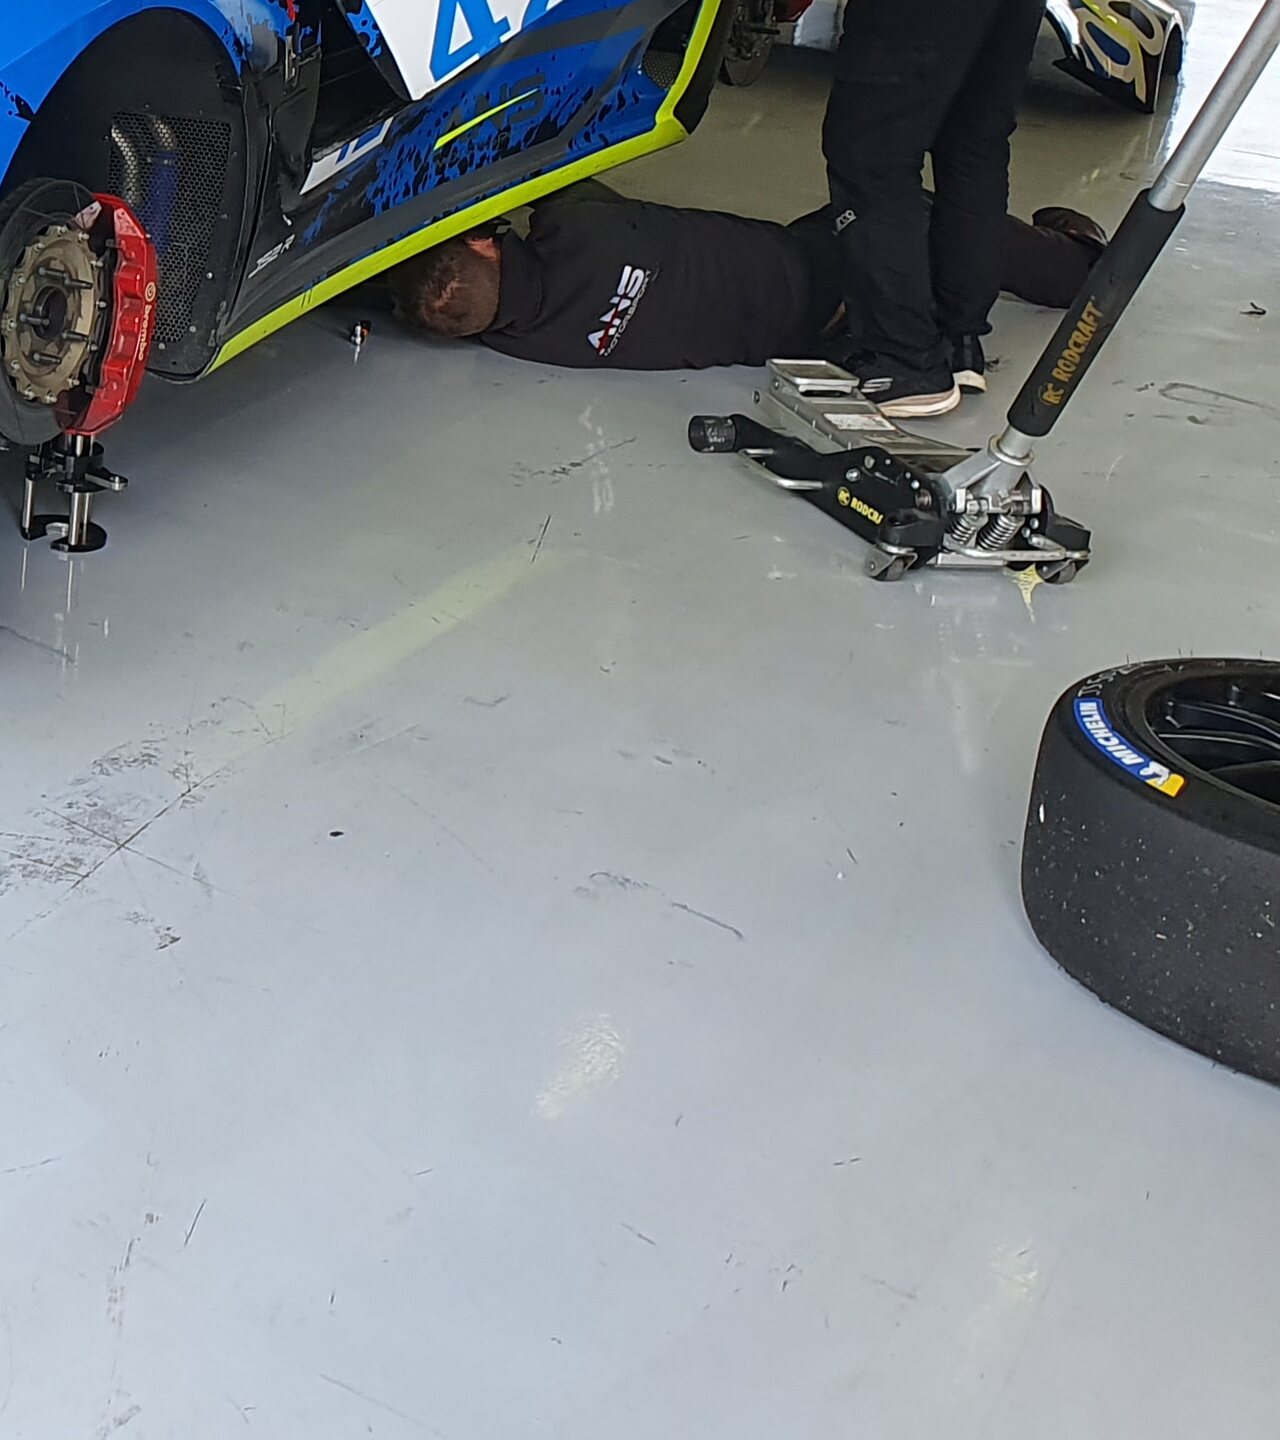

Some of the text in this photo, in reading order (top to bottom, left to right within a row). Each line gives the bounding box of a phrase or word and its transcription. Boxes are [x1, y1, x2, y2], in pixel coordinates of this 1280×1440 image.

[138, 304, 153, 361] brembo
[1051, 300, 1104, 383] RODCRAFT
[1079, 701, 1145, 766] MICHELIN
